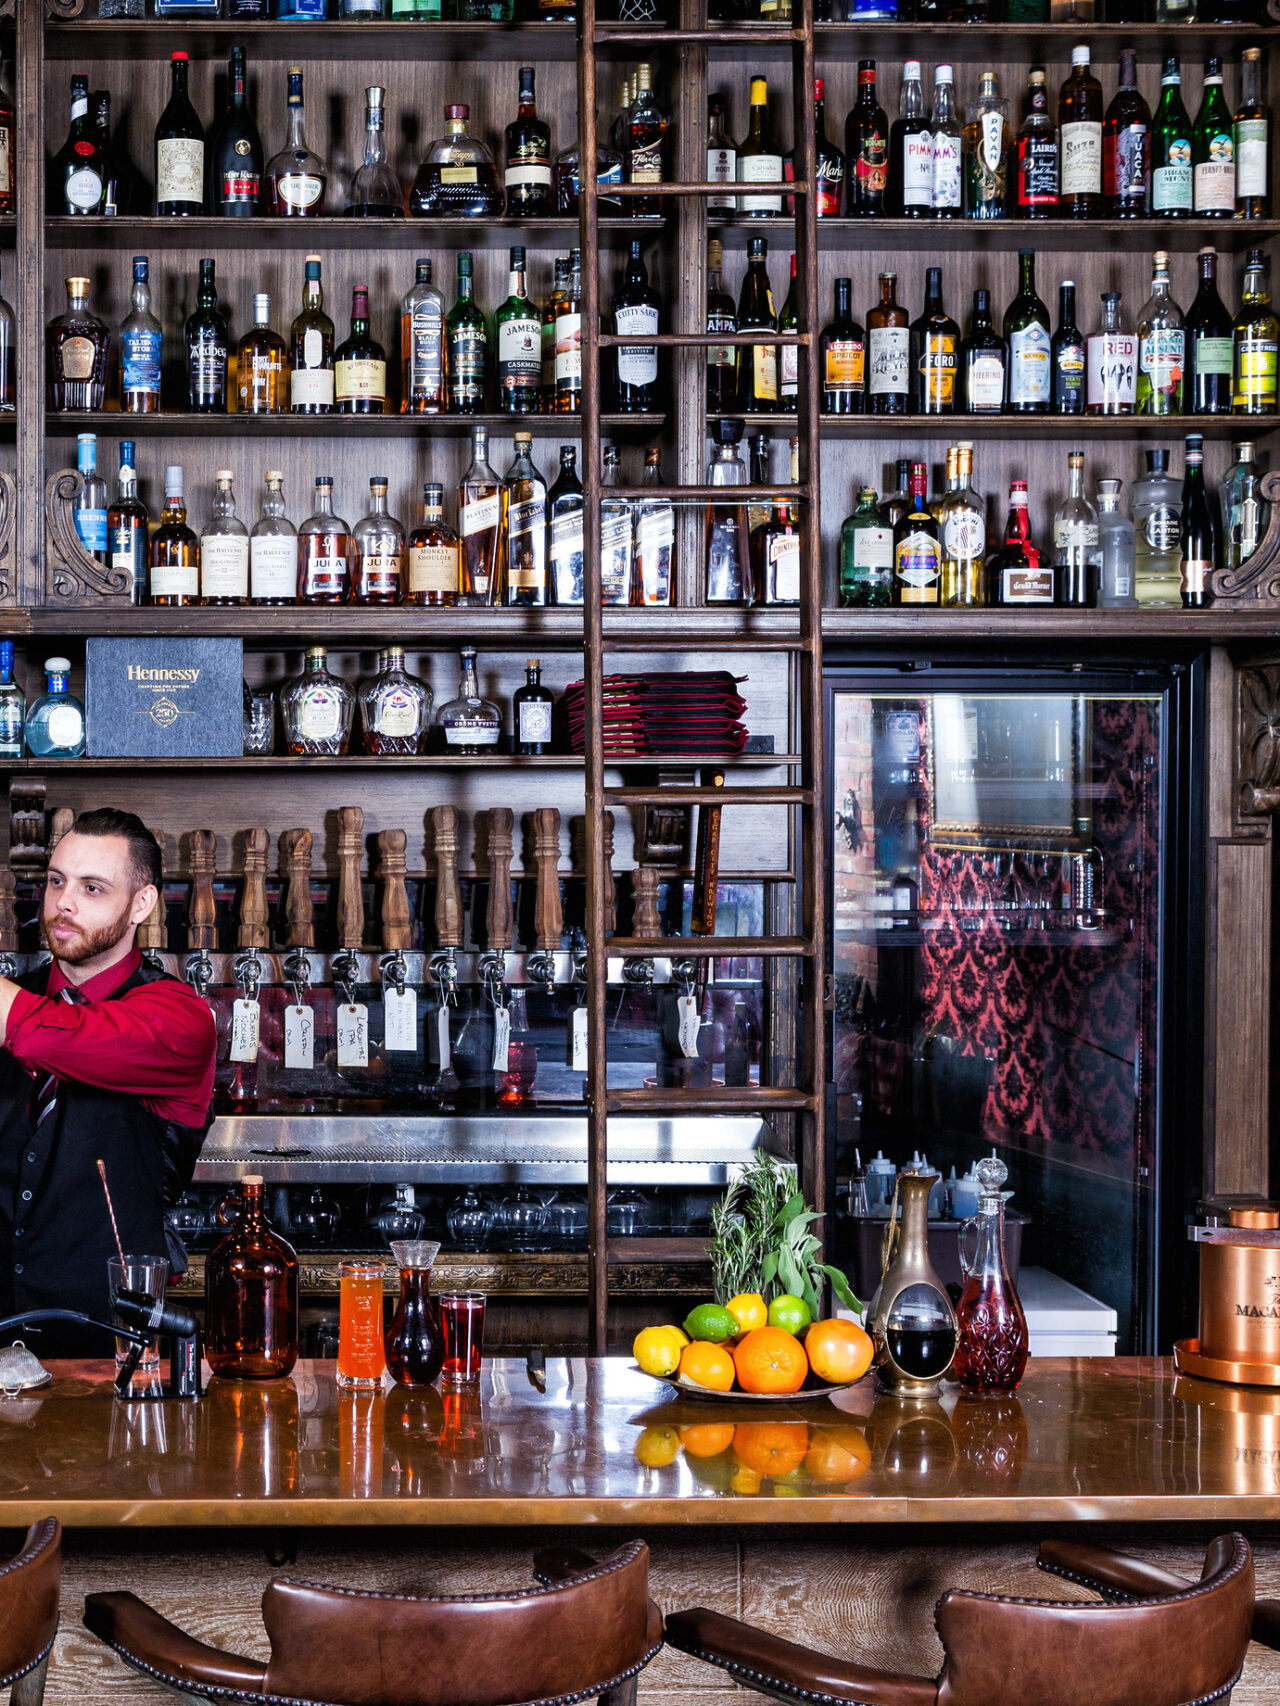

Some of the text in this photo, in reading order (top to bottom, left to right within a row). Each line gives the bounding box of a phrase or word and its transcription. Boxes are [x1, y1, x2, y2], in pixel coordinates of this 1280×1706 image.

[990, 118, 999, 160] PAVAN
[1031, 144, 1058, 153] LAIRD'S
[1133, 133, 1144, 179] TUACA
[618, 308, 657, 320] CUTTY SARK
[412, 321, 442, 329] BUSHMILLS
[506, 324, 541, 336] JAMESON
[453, 331, 486, 343] JAMESON
[190, 344, 226, 358] Ardbeg
[830, 343, 862, 351] LUXARDO
[1103, 342, 1132, 355] RED
[832, 351, 861, 359] APRICOT
[929, 354, 954, 367] FORO
[974, 370, 1001, 379] HEERING
[467, 505, 499, 520] PLATINUM
[513, 505, 544, 523] Blue Label
[417, 554, 451, 562] SHOULDER
[420, 548, 450, 556] MONKEY
[314, 559, 343, 568] JURA
[367, 558, 397, 568] JURA
[1013, 581, 1051, 590] Grand Marnier
[128, 664, 200, 683] Hennessy
[706, 881, 715, 928] BREWING
[239, 1015, 249, 1050] NOCHES
[249, 1012, 259, 1048] BUENAS
[347, 1029, 355, 1045] IPA
[356, 1016, 366, 1060] LAGUNITAS
